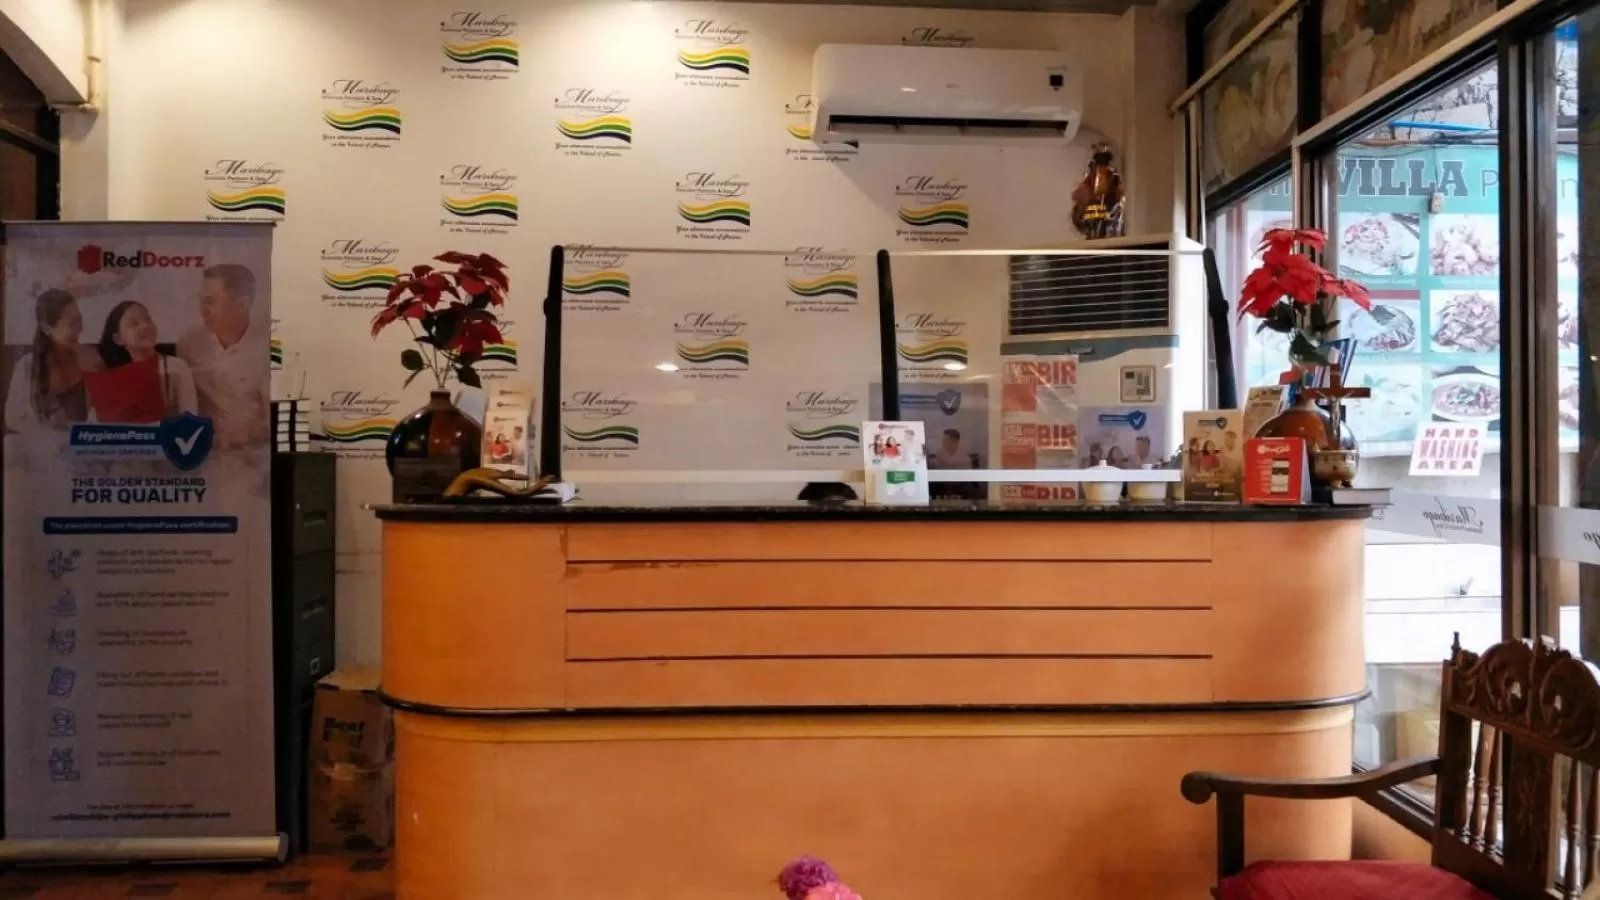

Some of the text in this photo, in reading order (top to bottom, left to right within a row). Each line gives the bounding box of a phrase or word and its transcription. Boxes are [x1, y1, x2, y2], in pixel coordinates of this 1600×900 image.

[440, 12, 517, 33] Maribago
[674, 20, 749, 41] Maribago
[322, 80, 400, 101] Maribago
[555, 88, 630, 109] Maribago
[205, 160, 284, 181] Maribago
[440, 164, 517, 185] Maribago
[1337, 158, 1469, 197] VILLA
[676, 172, 750, 193] Maribago
[895, 176, 968, 197] Maribago
[103, 250, 204, 268] RedDoorz
[322, 240, 399, 261] Maribago
[675, 312, 747, 333] Maribago
[896, 313, 966, 334] Maribago
[1037, 361, 1076, 385] BIR
[321, 391, 398, 412] Maribago
[562, 391, 637, 412] Maribago
[787, 391, 859, 412] Maribago
[78, 430, 156, 442] HygienePass
[1037, 424, 1076, 447] BIR
[1425, 428, 1479, 438] HAND
[1419, 439, 1479, 459] WASHING
[1418, 460, 1473, 470] AREA
[73, 477, 206, 487] THE GOLDEN STANDARD
[72, 488, 206, 503] FOR QUALITY
